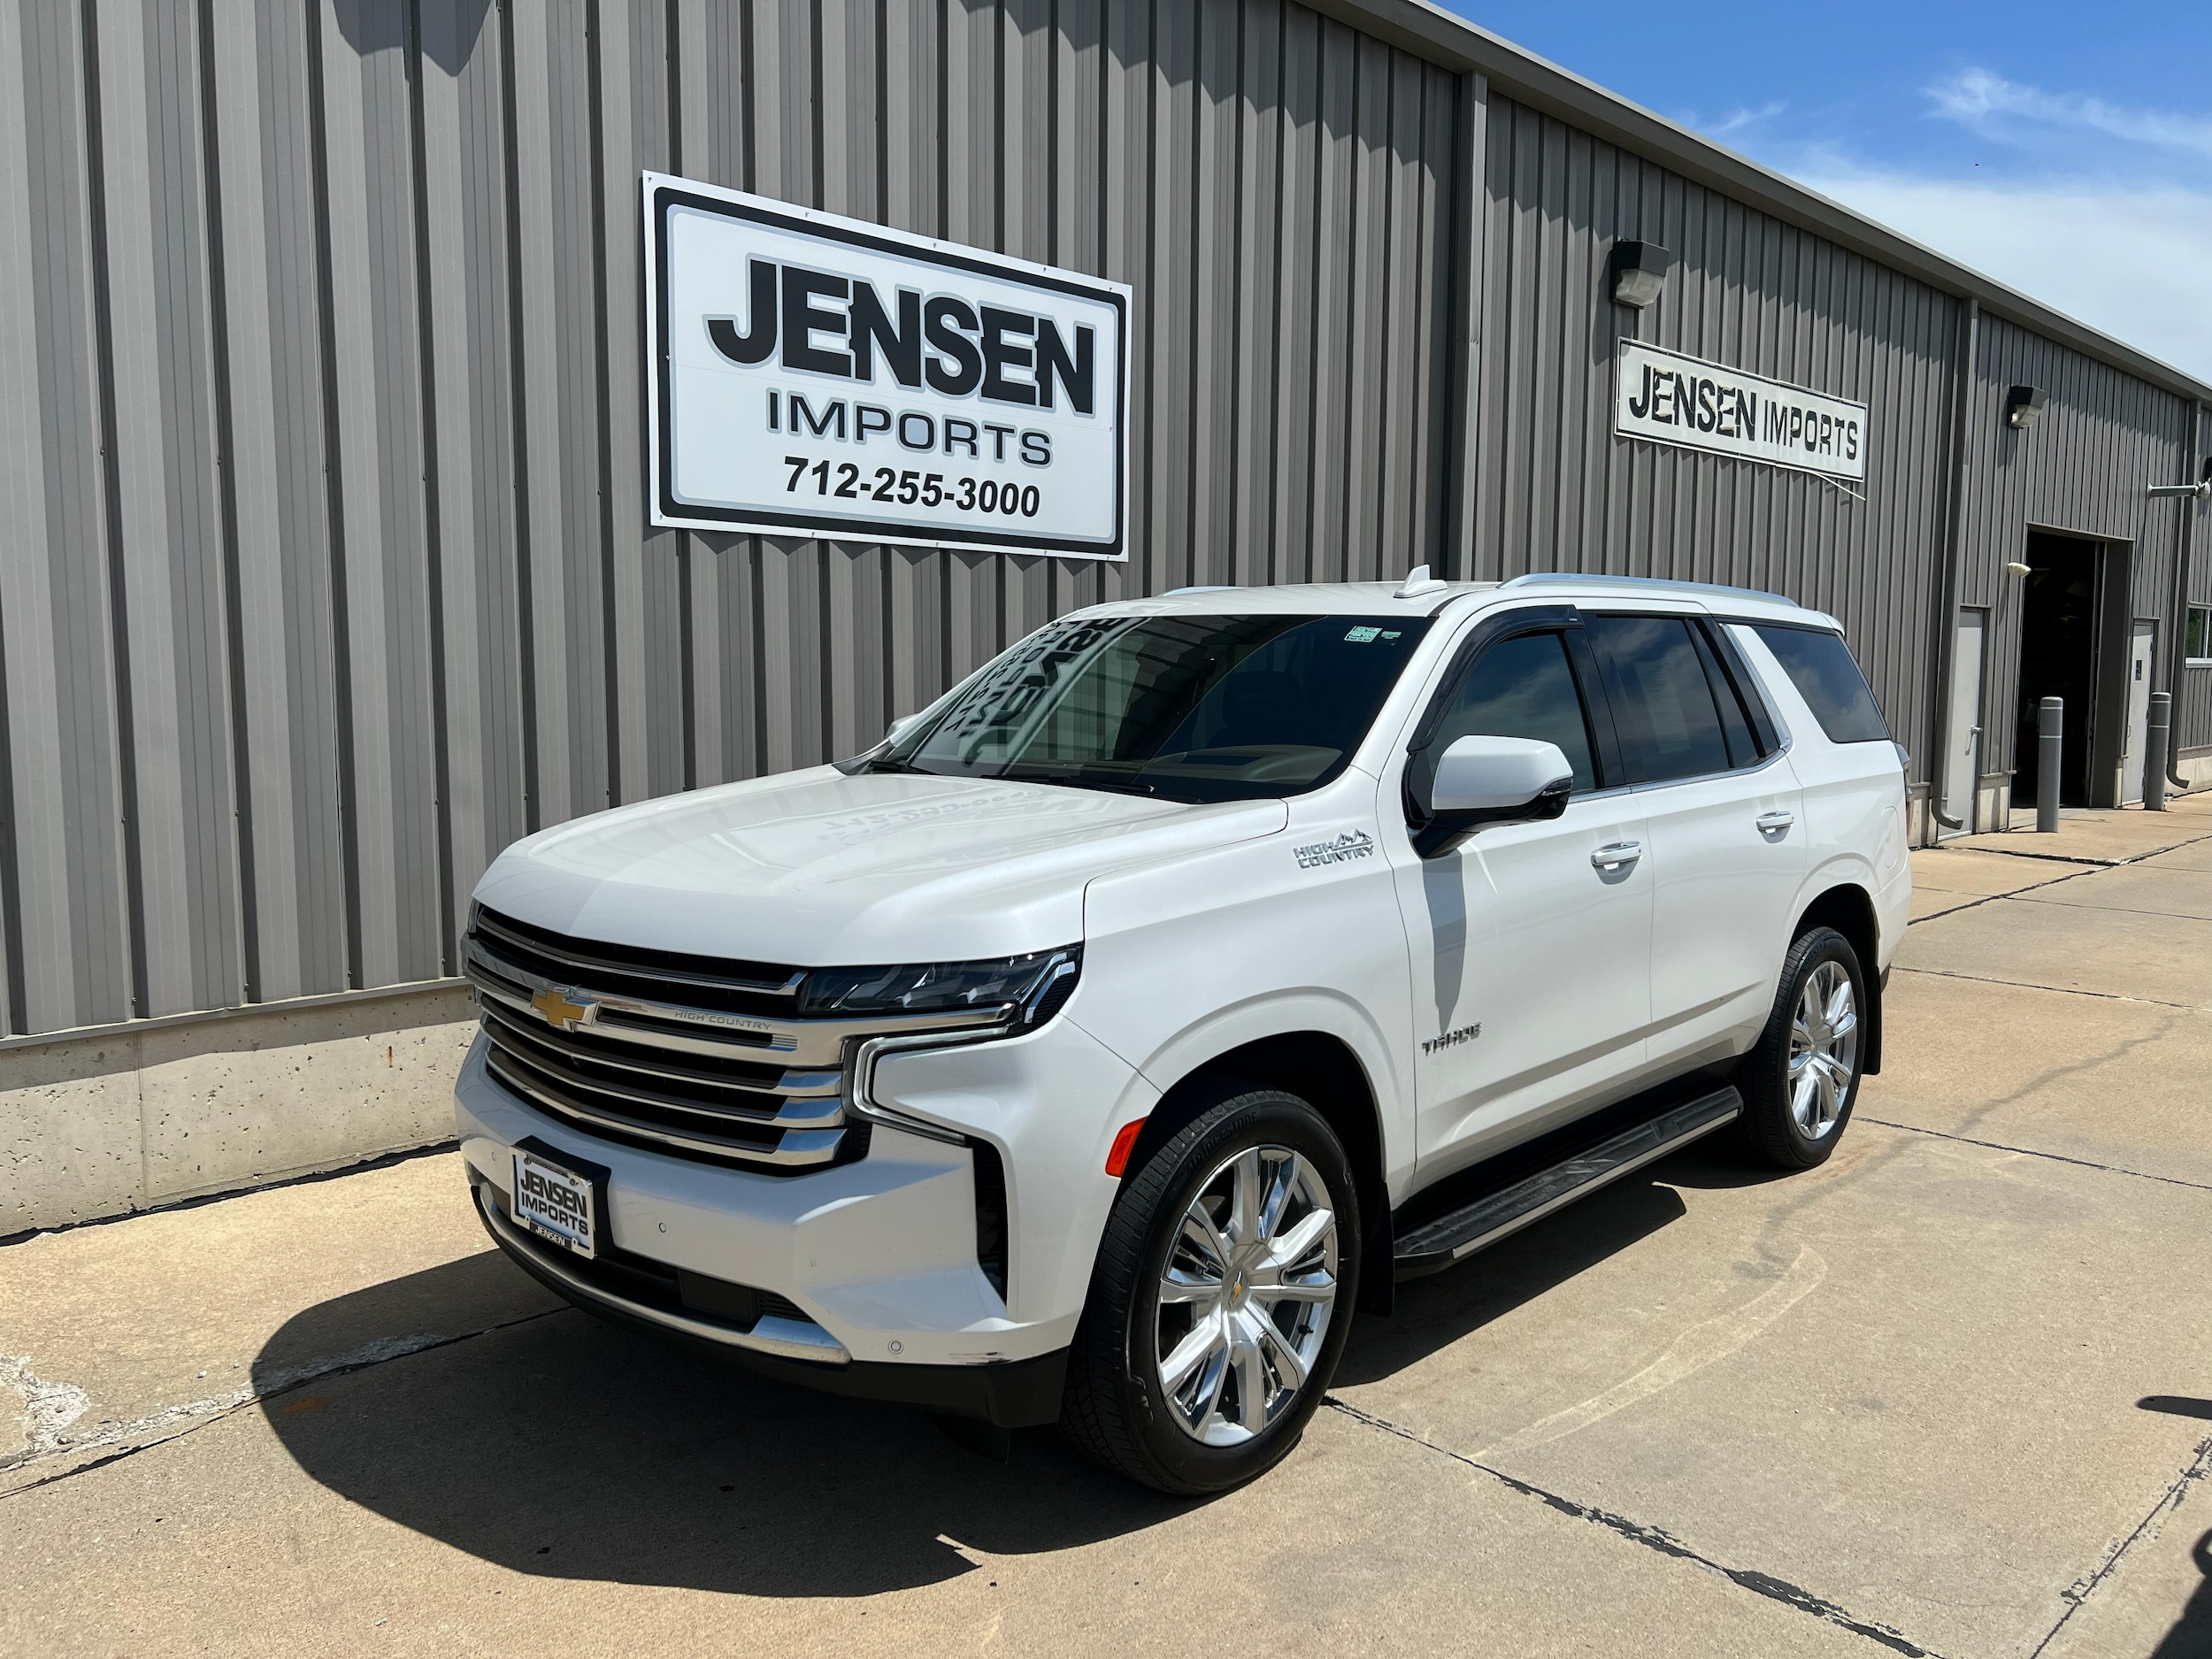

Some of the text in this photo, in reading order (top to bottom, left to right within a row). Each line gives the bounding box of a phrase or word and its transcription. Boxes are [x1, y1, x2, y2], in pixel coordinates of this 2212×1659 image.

[704, 256, 1095, 417] JENSEN
[767, 388, 1053, 467] IMPORTS
[1628, 363, 1859, 461] JENSEN IMPORTS
[784, 456, 1041, 518] 712-255-3000
[1293, 841, 1335, 858] HIGH
[1298, 845, 1374, 869] COUNTRY
[674, 1010, 772, 1030] HIGH COUNTRY
[1421, 1021, 1482, 1056] TAHOE
[520, 1169, 588, 1219] JENSEN
[521, 1192, 589, 1236] IMPORTS
[534, 1226, 566, 1247] JENSEN
